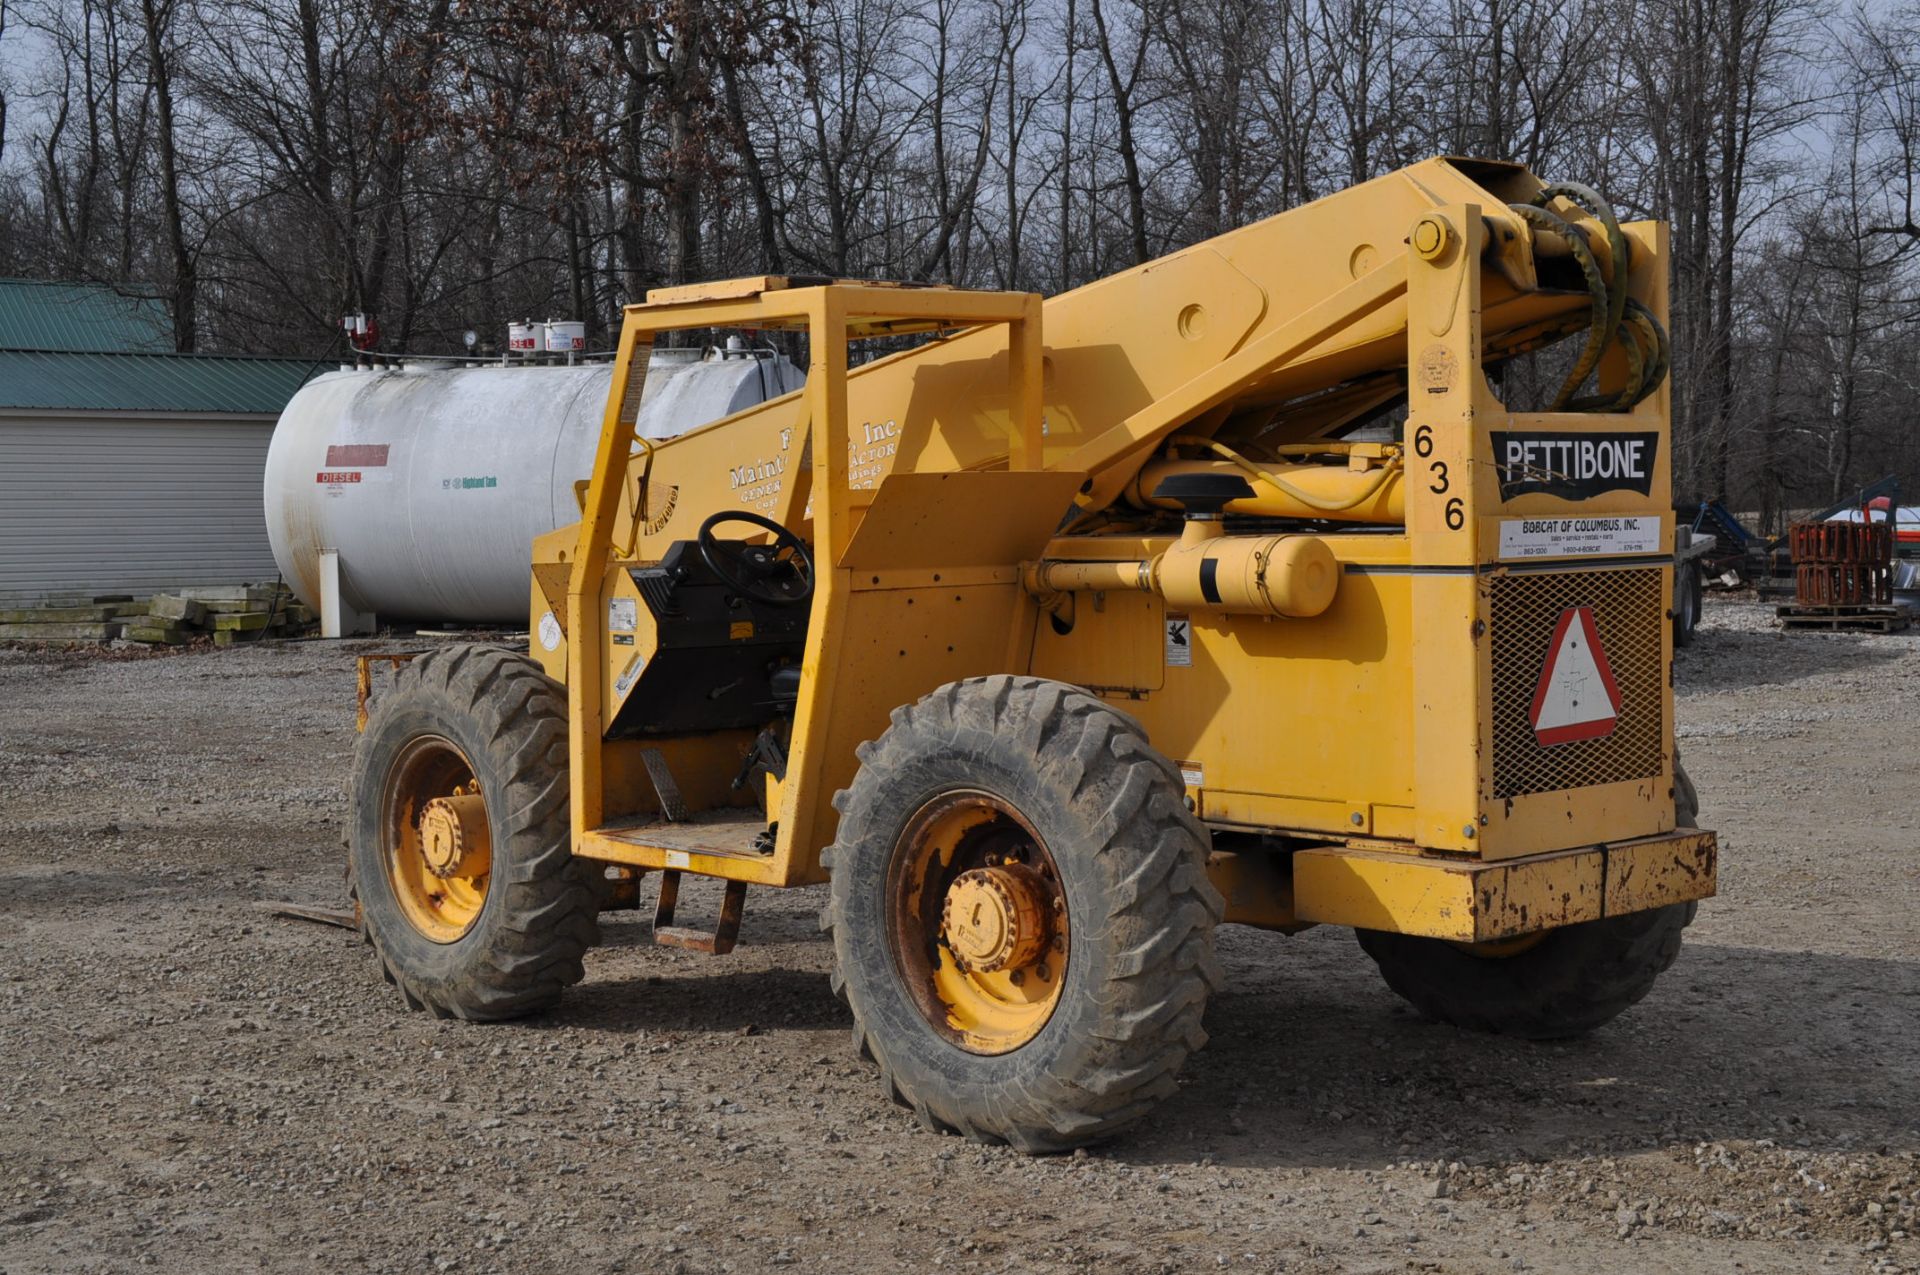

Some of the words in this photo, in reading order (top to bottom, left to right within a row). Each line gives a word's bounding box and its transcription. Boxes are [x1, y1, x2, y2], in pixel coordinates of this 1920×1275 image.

[511, 339, 533, 348] SEL
[730, 454, 788, 488] Maint
[863, 420, 901, 445] Inc.
[1506, 440, 1645, 482] PETTIBONE
[322, 473, 359, 483] DIESEL
[741, 480, 782, 503] GENER
[850, 443, 895, 468] ACTOR
[1522, 520, 1558, 534] BOBCAT
[1561, 520, 1572, 533] OF
[1574, 519, 1622, 532] COLUMBUS,
[1624, 518, 1640, 531] INC.
